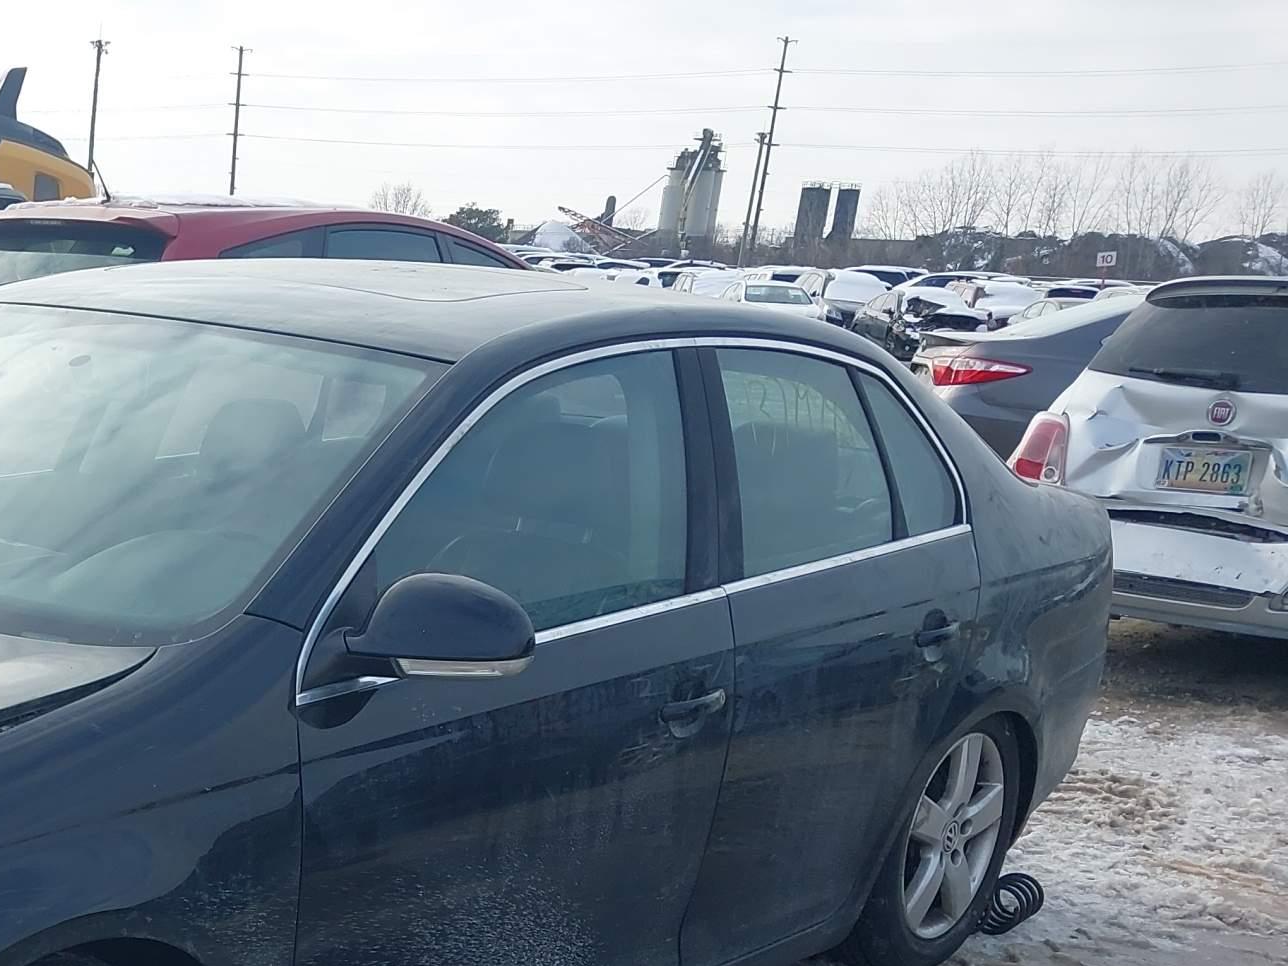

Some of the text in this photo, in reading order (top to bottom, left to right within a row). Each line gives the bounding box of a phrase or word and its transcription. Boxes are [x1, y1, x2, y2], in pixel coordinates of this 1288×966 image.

[1100, 254, 1113, 265] 10
[1212, 406, 1230, 420] FIAT
[1162, 459, 1242, 485] KTP 2863
